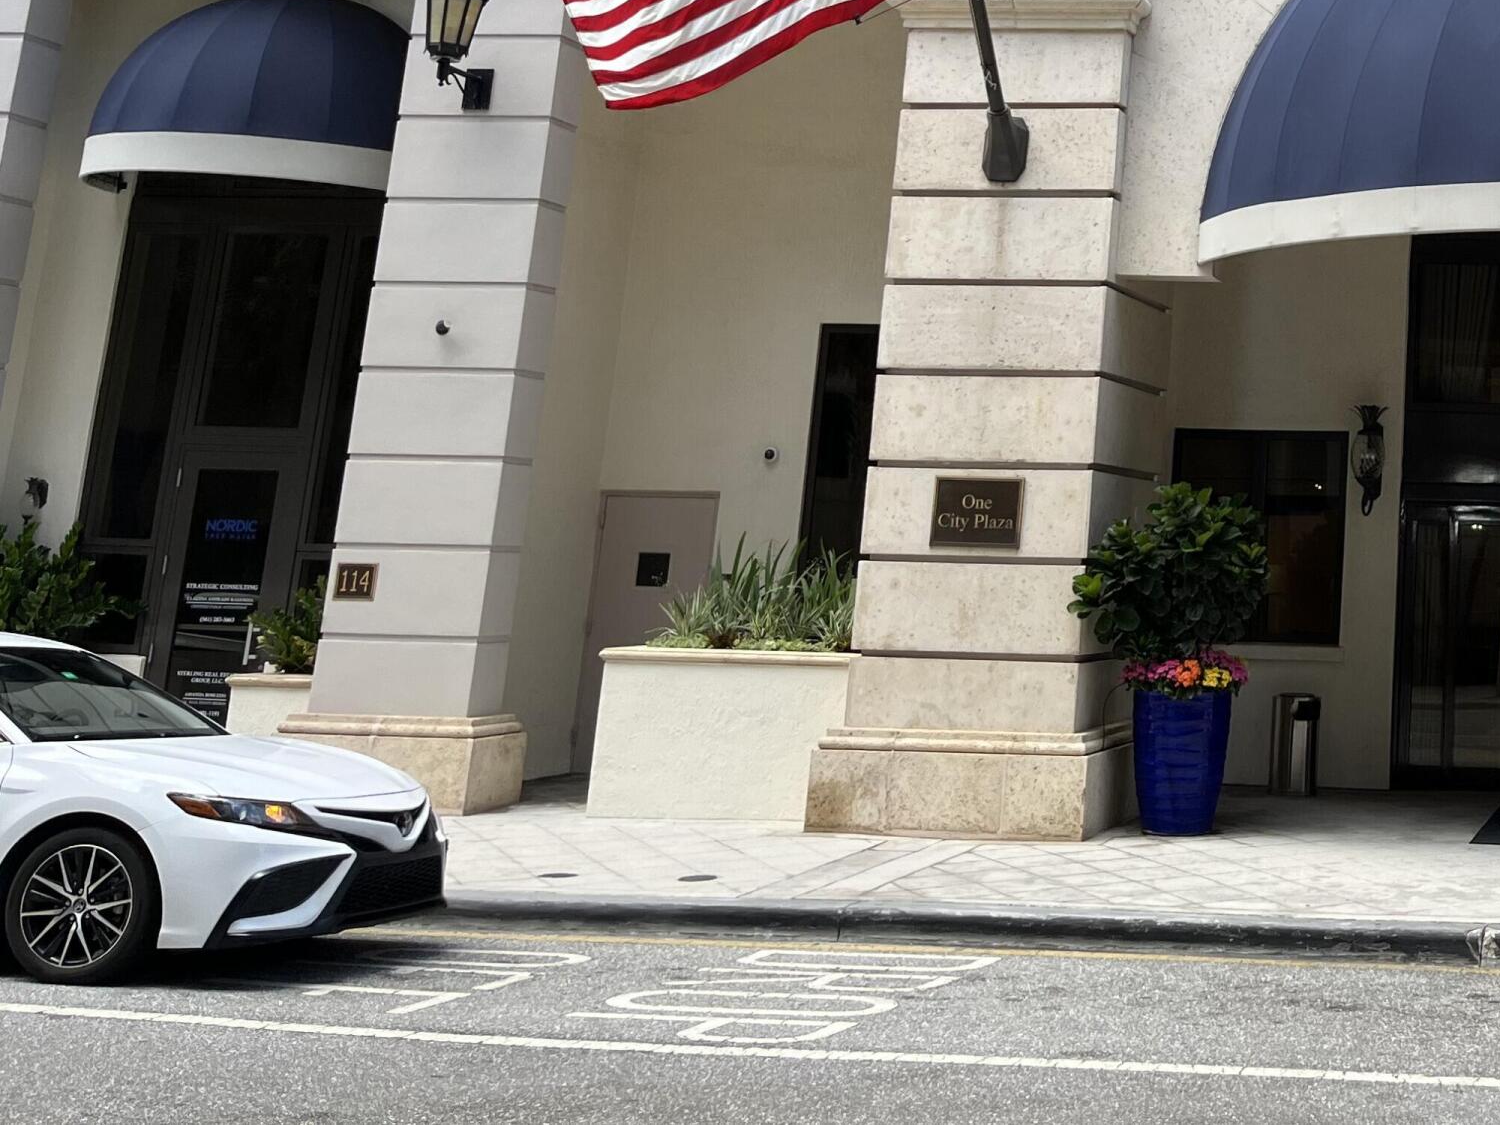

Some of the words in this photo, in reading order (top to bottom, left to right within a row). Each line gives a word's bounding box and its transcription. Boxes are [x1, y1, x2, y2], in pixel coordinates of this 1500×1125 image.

[962, 494, 993, 510] One
[938, 512, 970, 532] City
[974, 513, 1014, 530] Plaza
[340, 570, 370, 593] 114
[565, 949, 1002, 1043] DROP
